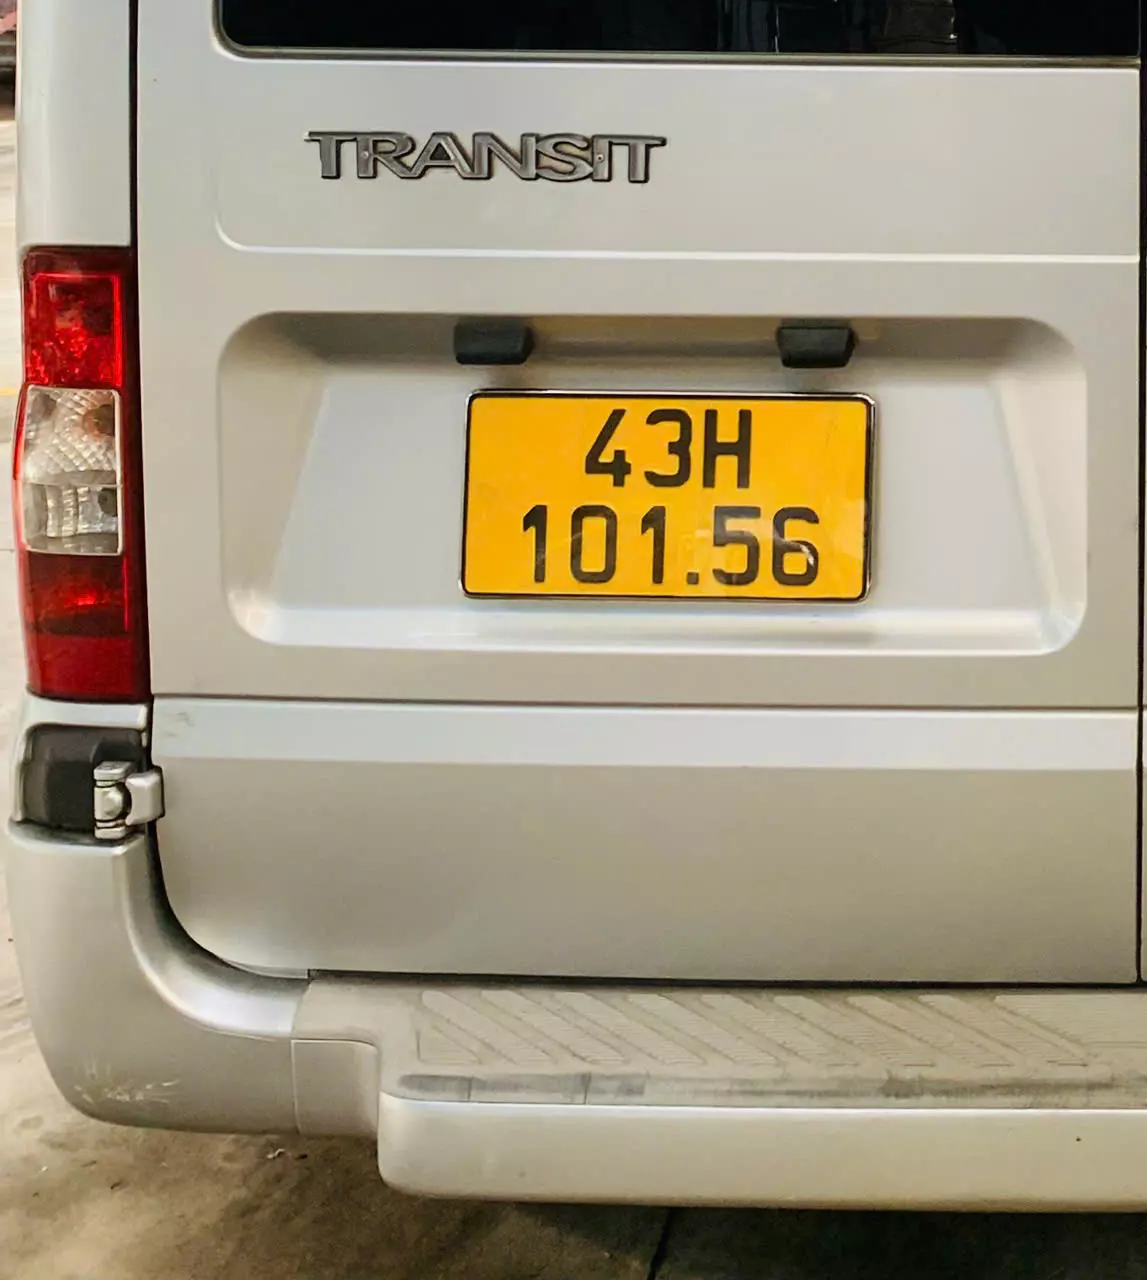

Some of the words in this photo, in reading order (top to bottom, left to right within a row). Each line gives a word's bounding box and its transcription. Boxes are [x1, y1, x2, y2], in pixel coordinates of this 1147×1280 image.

[304, 130, 667, 183] TRANSIT
[584, 408, 752, 489] 43H
[522, 505, 820, 588] 101.56
